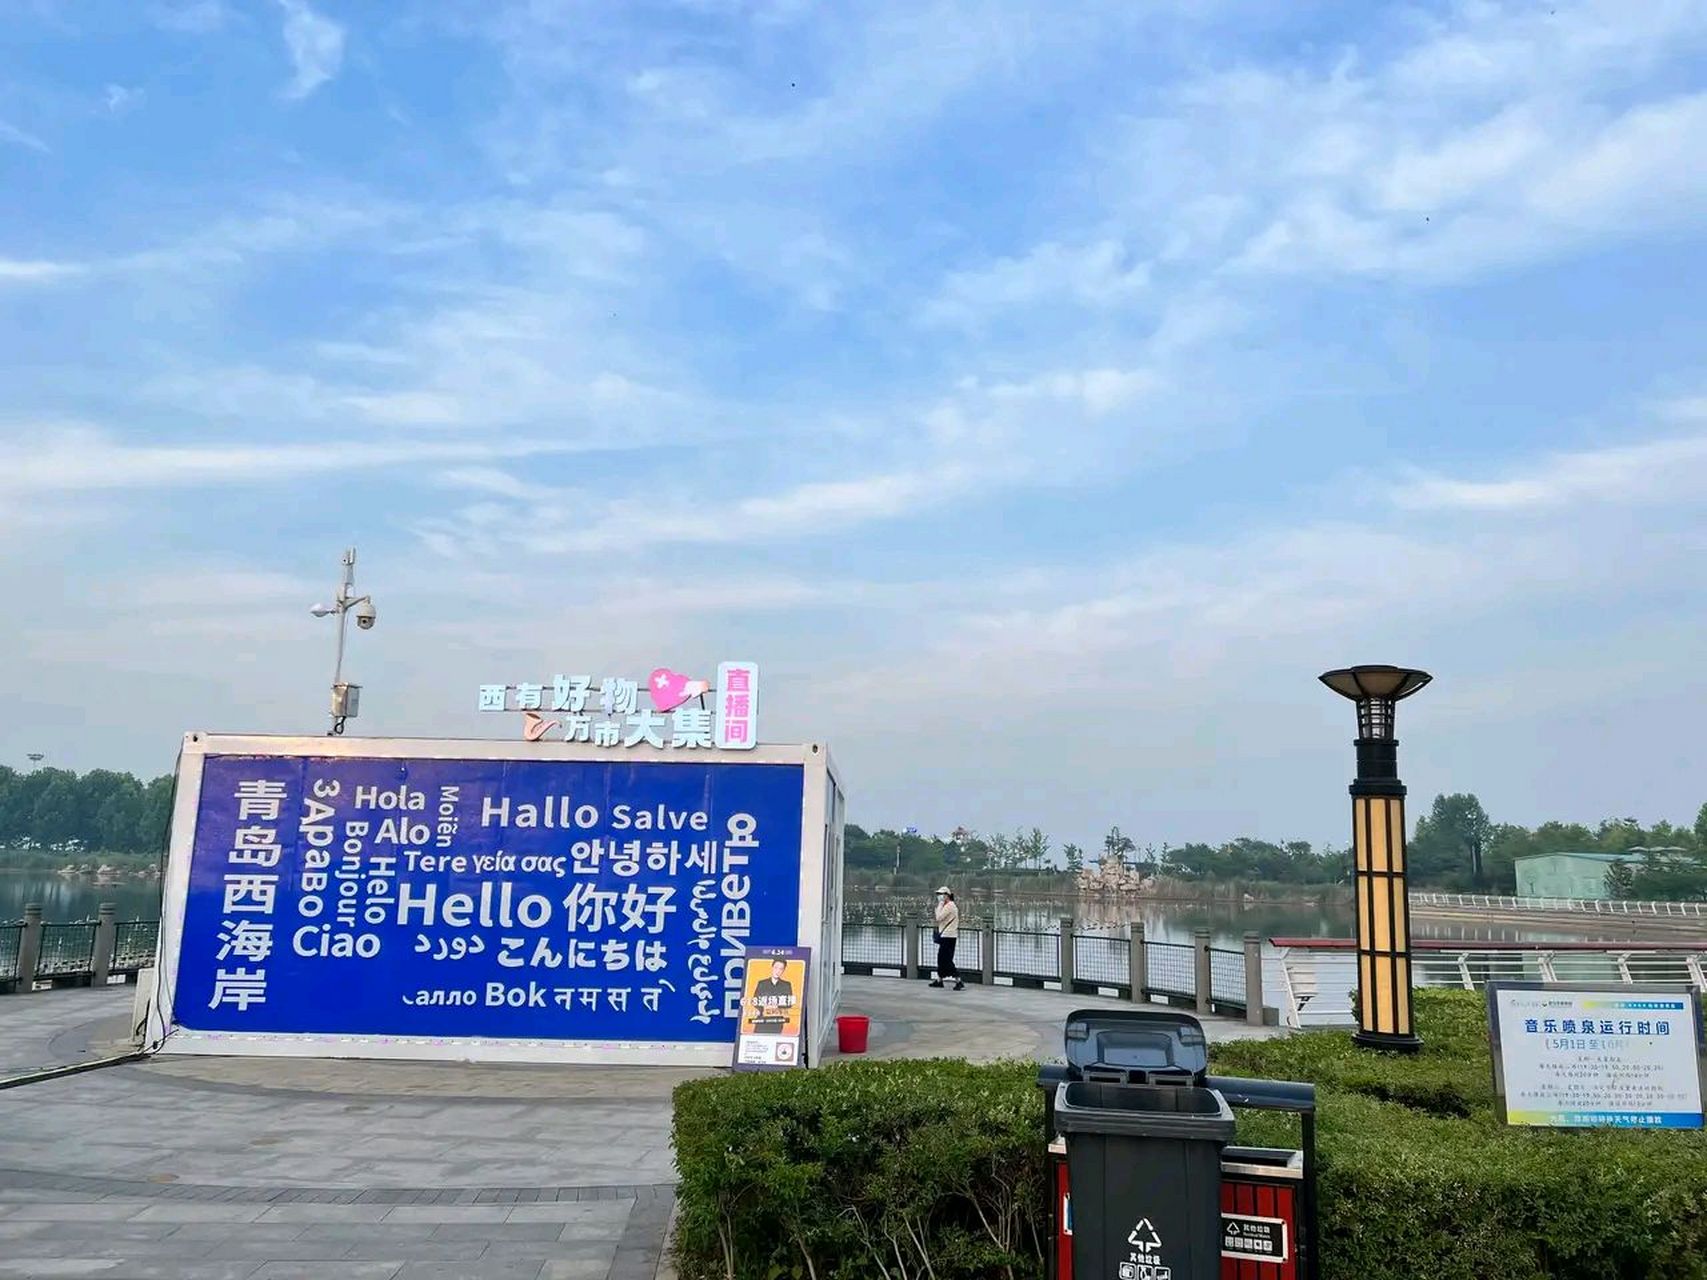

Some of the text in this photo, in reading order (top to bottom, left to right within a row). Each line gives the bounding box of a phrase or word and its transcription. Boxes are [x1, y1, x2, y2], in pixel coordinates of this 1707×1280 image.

[479, 674, 639, 715] 西有好物
[725, 668, 752, 744] 直播间
[354, 785, 426, 811] Hola
[481, 796, 709, 831] Hallo Salve
[374, 817, 431, 845] Alo
[335, 821, 369, 928] Bonjour
[403, 851, 467, 873] Tere
[208, 780, 287, 1011] 青岛西海岸
[364, 857, 397, 925] Helo
[396, 881, 553, 929] Hello
[562, 882, 677, 935] 你好
[292, 923, 382, 959] Ciao
[497, 936, 668, 971] こんにちは
[484, 981, 547, 1008] Bok
[1525, 1018, 1670, 1035] 音乐喷泉运行时间
